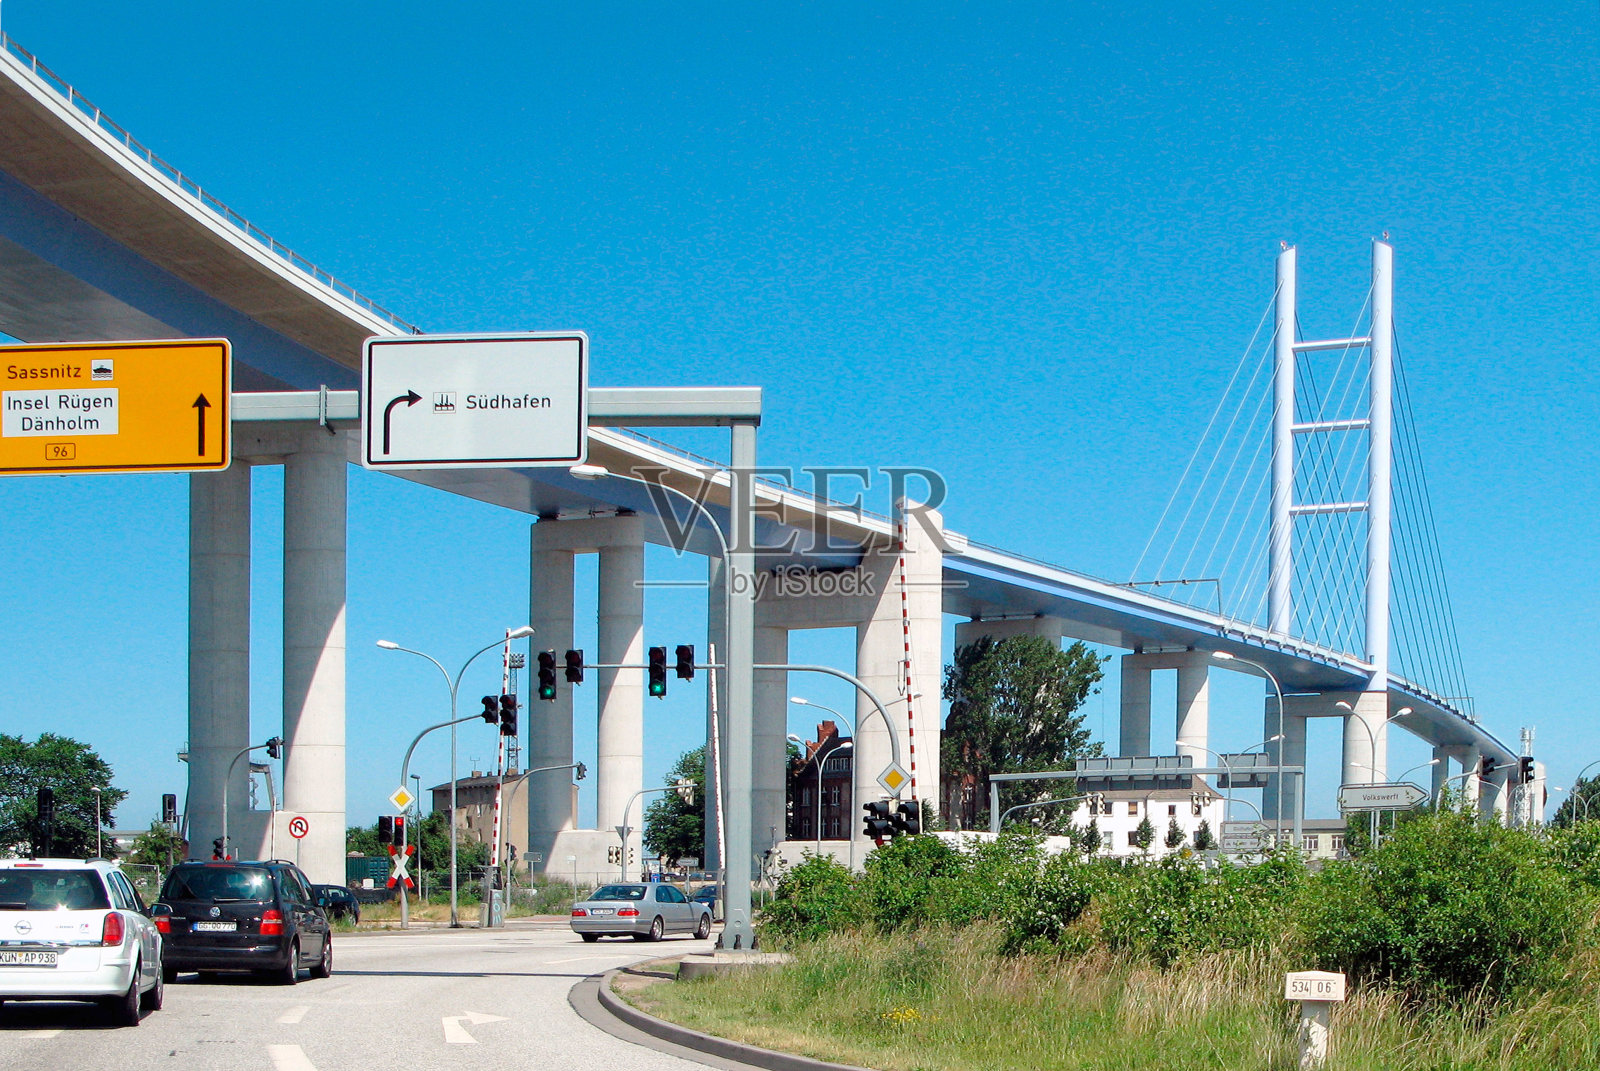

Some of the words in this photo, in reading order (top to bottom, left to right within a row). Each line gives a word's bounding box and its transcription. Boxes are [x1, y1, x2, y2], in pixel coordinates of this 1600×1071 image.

[7, 364, 82, 380] Sassnitz
[8, 395, 50, 410] Insel
[58, 394, 113, 412] Rügen
[466, 394, 551, 409] Südhafen
[22, 416, 99, 431] Dänholm
[53, 446, 68, 457] 96
[1363, 793, 1399, 801] Volkswerft
[24, 952, 36, 963] AP
[38, 952, 56, 963] 938
[1292, 981, 1309, 992] 534
[1317, 981, 1331, 993] 06
